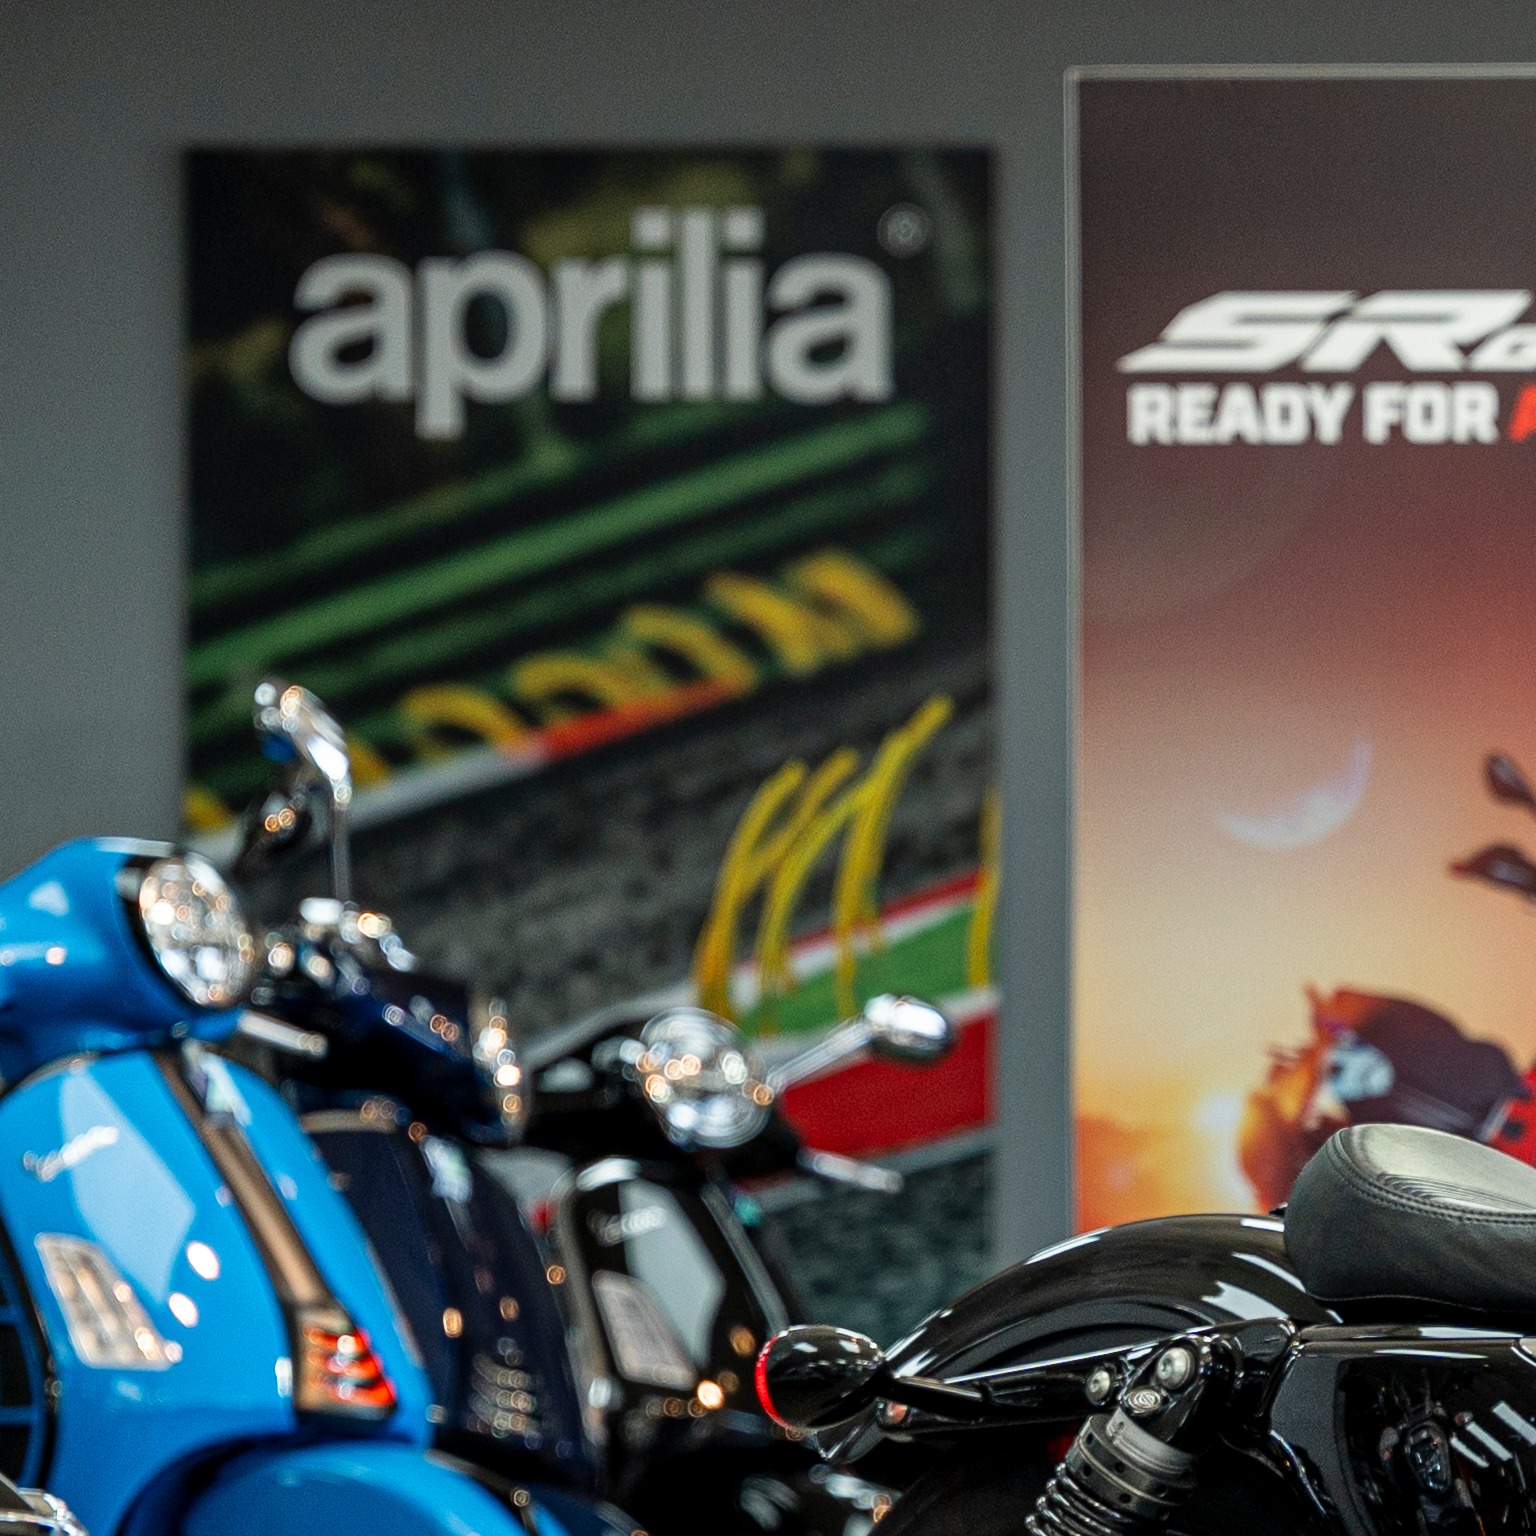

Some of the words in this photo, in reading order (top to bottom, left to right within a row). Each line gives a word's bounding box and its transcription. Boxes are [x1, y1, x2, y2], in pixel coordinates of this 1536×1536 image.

[287, 208, 895, 440] aprilia
[1116, 288, 1533, 373] SR
[1127, 381, 1354, 446] READY
[1361, 381, 1500, 445] FOR
